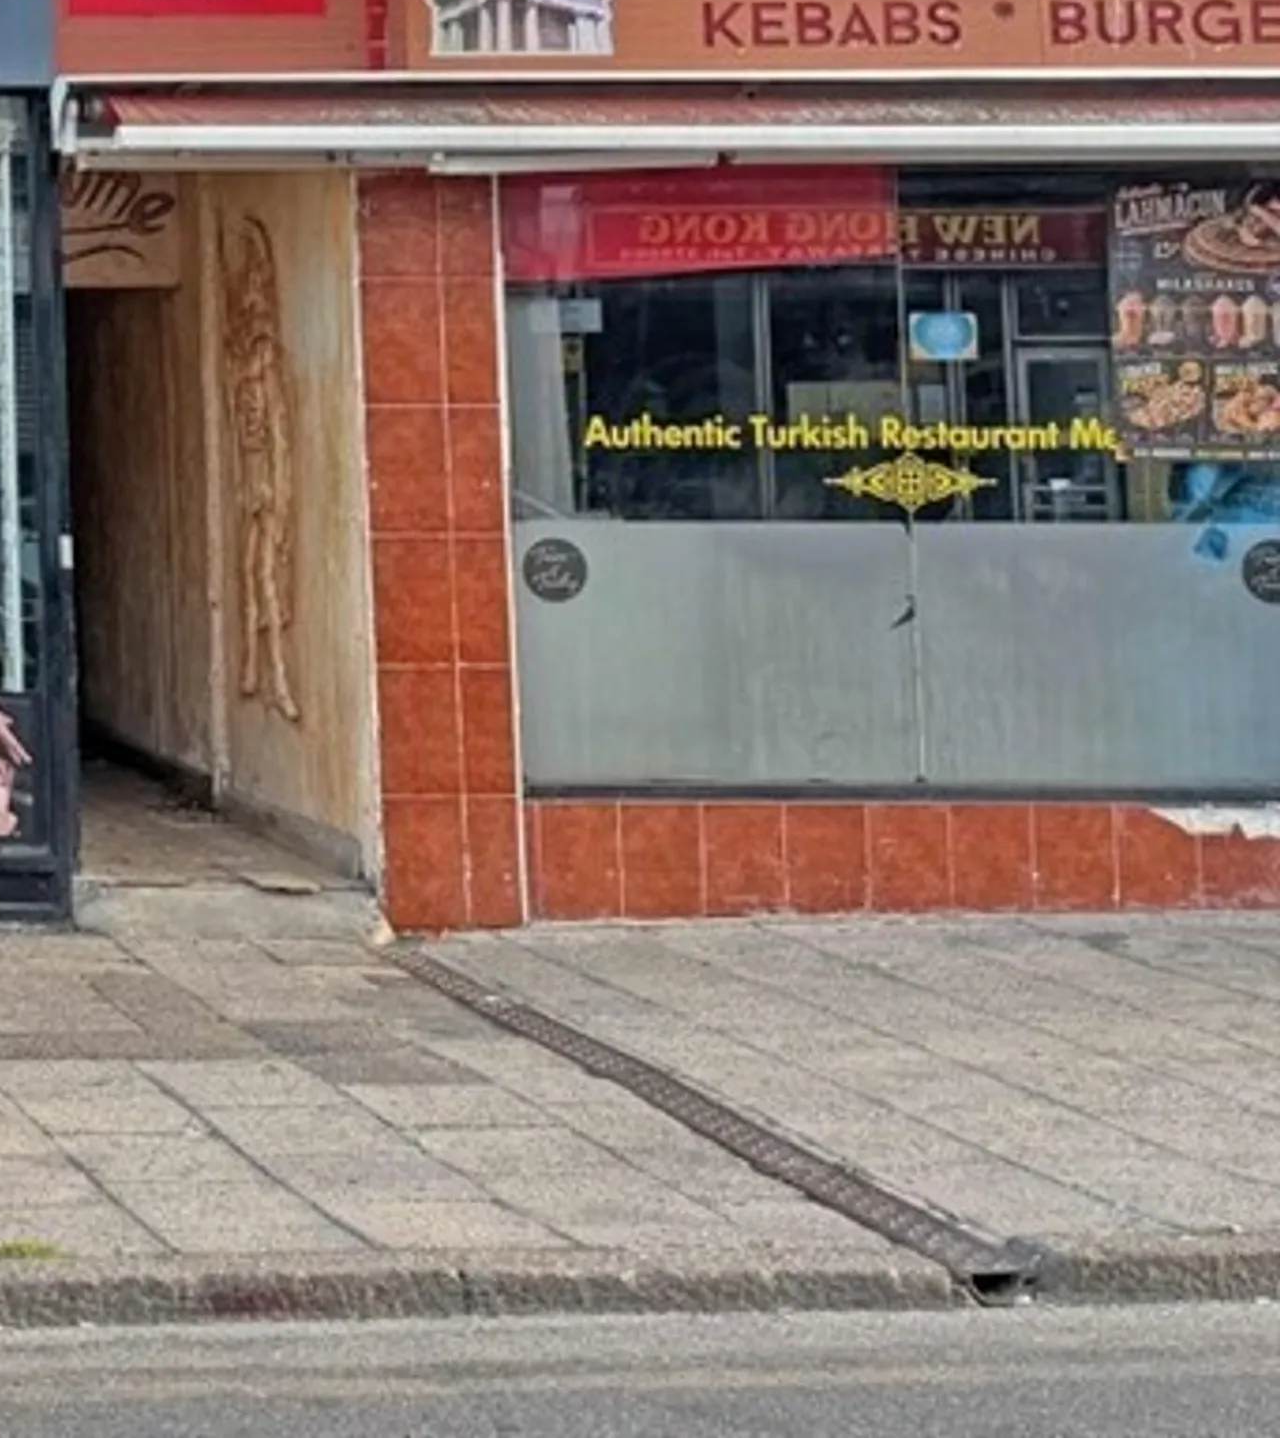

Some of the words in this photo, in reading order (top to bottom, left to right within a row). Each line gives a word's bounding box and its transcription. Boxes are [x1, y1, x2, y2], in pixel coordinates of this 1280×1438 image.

[702, 0, 962, 48] KEBABS
[1050, 0, 1280, 46] BURGE
[584, 414, 742, 450] Authentic
[748, 414, 869, 450] Turkish
[883, 417, 1059, 450] Restaurant
